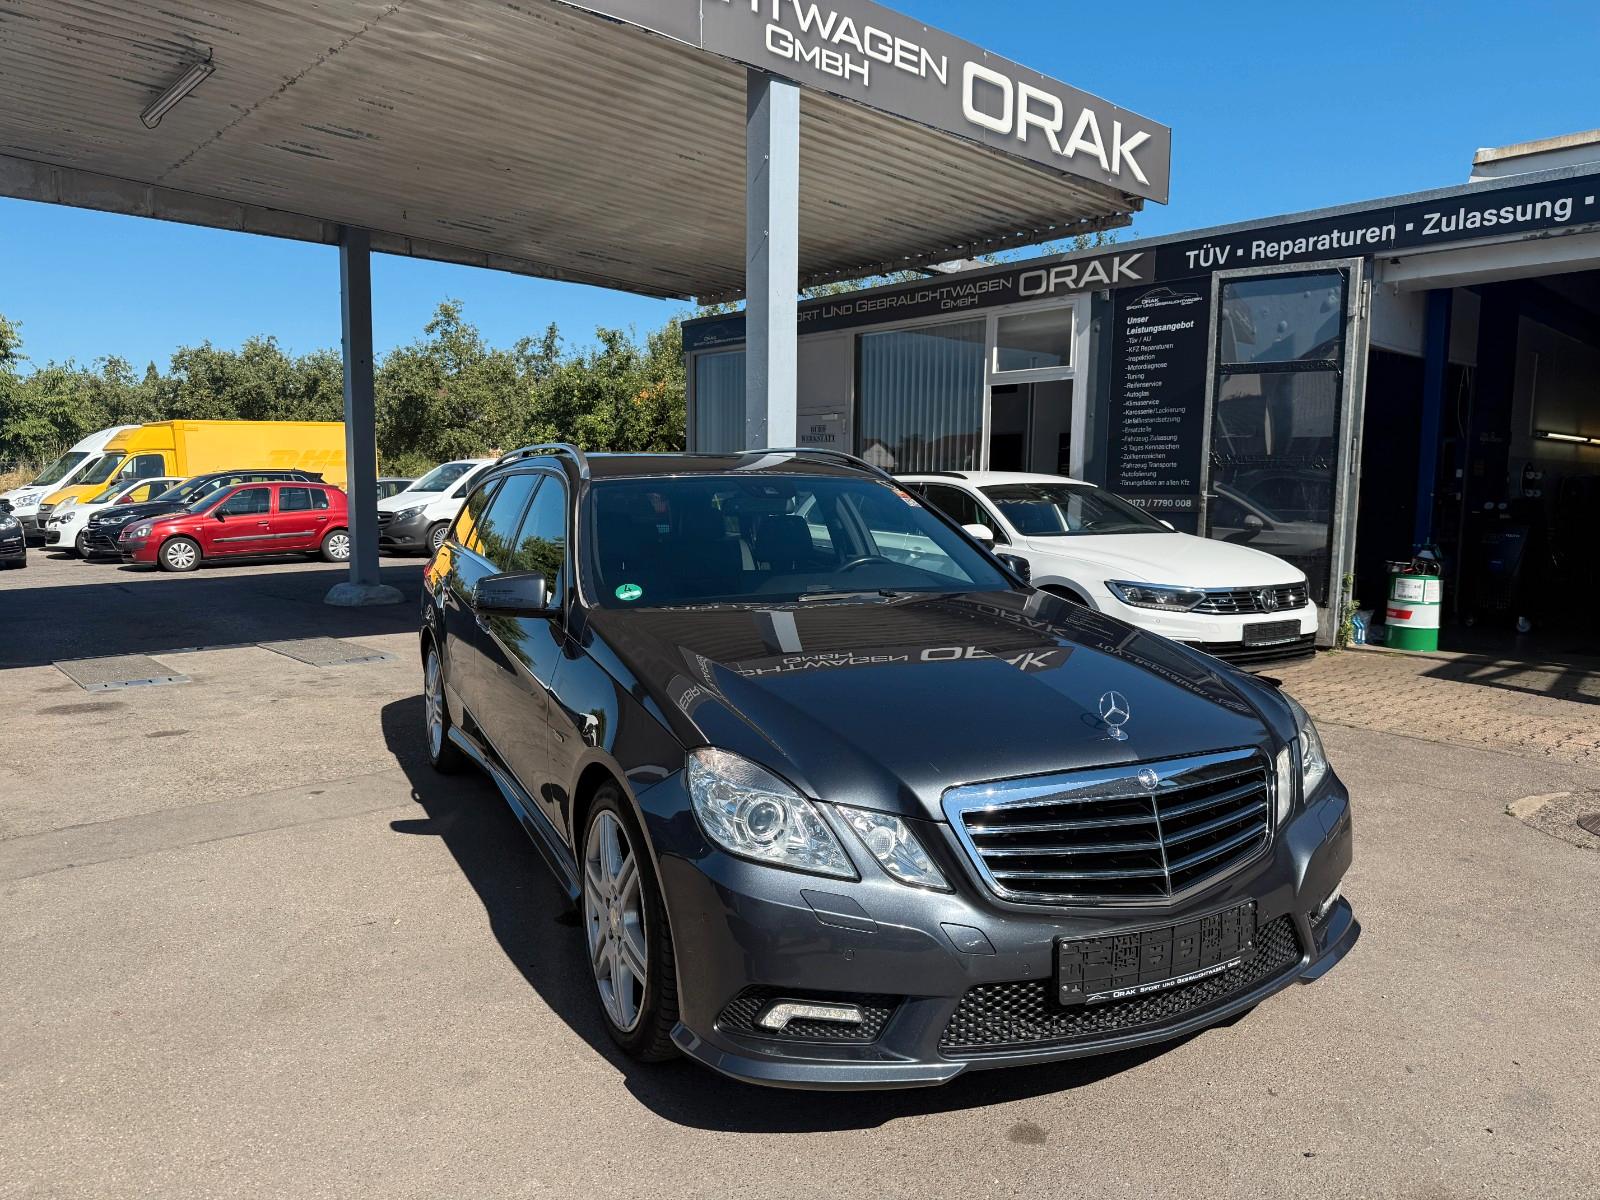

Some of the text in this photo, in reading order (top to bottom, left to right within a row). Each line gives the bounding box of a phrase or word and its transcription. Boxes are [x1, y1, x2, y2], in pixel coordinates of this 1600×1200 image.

[765, 23, 870, 87] GMBH
[962, 60, 1152, 187] ORAK
[1185, 196, 1573, 270] TÜV Reparaturen Zulassung
[822, 304, 853, 318] UND
[856, 276, 1012, 314] GEBRAUCHTWAGEN
[1018, 252, 1145, 297] ORAK
[940, 295, 978, 310] GMBH
[1126, 320, 1195, 335] Leistungsangebot
[1127, 315, 1149, 325] Unser
[1153, 499, 1173, 508] 7790
[1174, 498, 1192, 508] 008
[1113, 988, 1136, 998] ORAK
[1139, 984, 1161, 993] SPORT
[1162, 980, 1175, 988] UND
